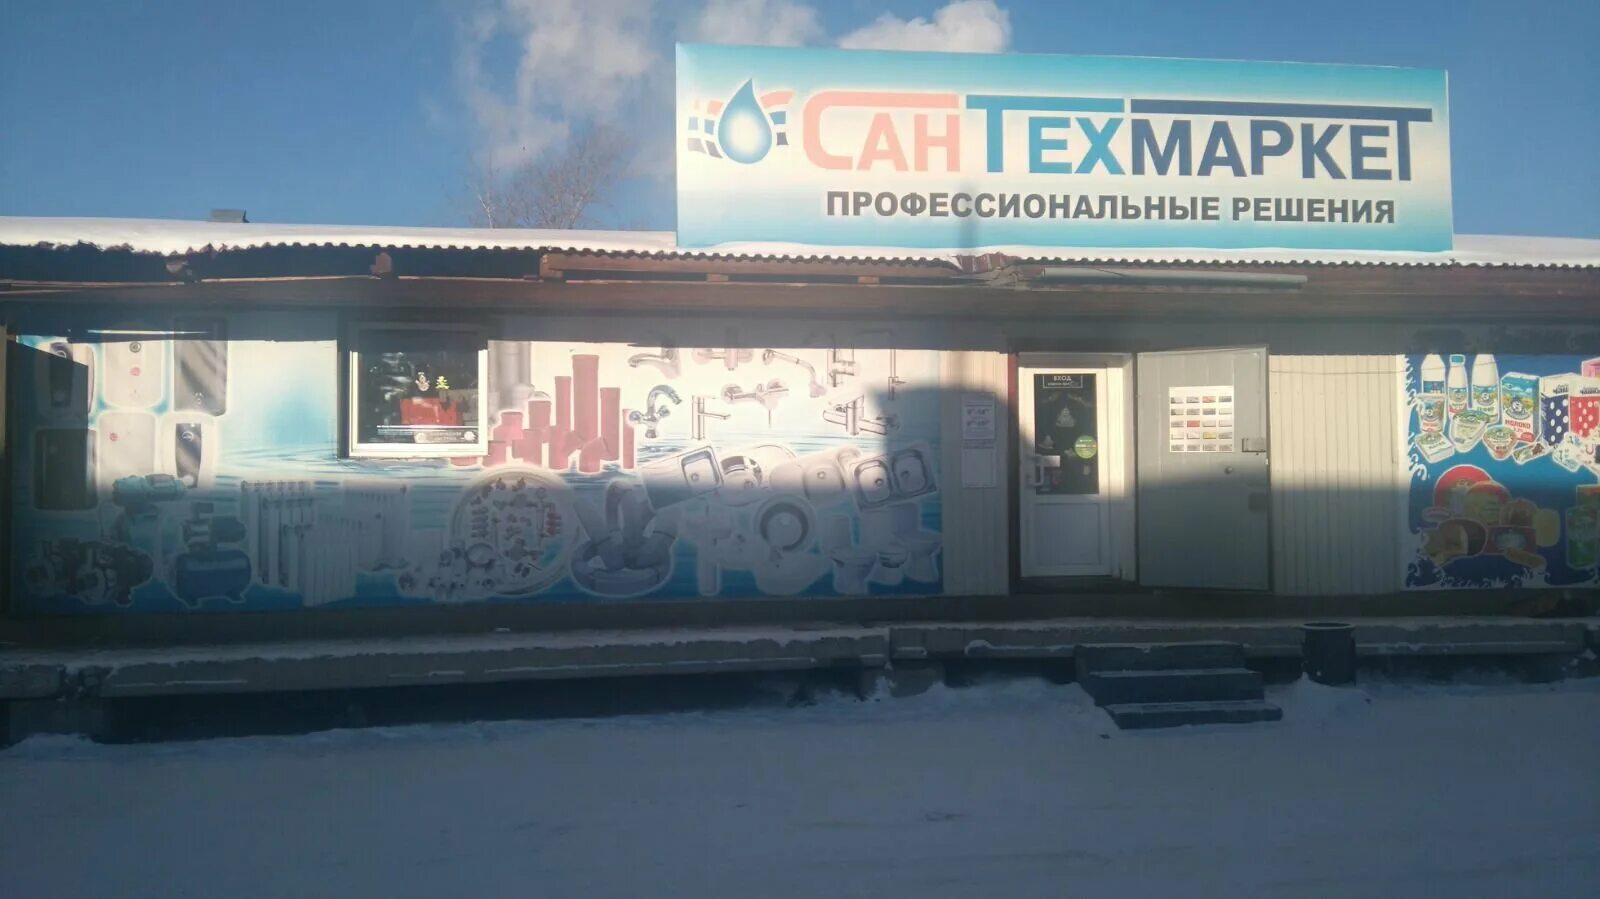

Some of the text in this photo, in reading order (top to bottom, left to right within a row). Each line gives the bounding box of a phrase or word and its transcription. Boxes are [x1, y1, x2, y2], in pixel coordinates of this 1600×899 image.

[826, 191, 1395, 224] ПРОФЕССИОНАЛЬНЫЕ РЕШЕНИЯ
[1505, 419, 1531, 429] МОЛОКО
